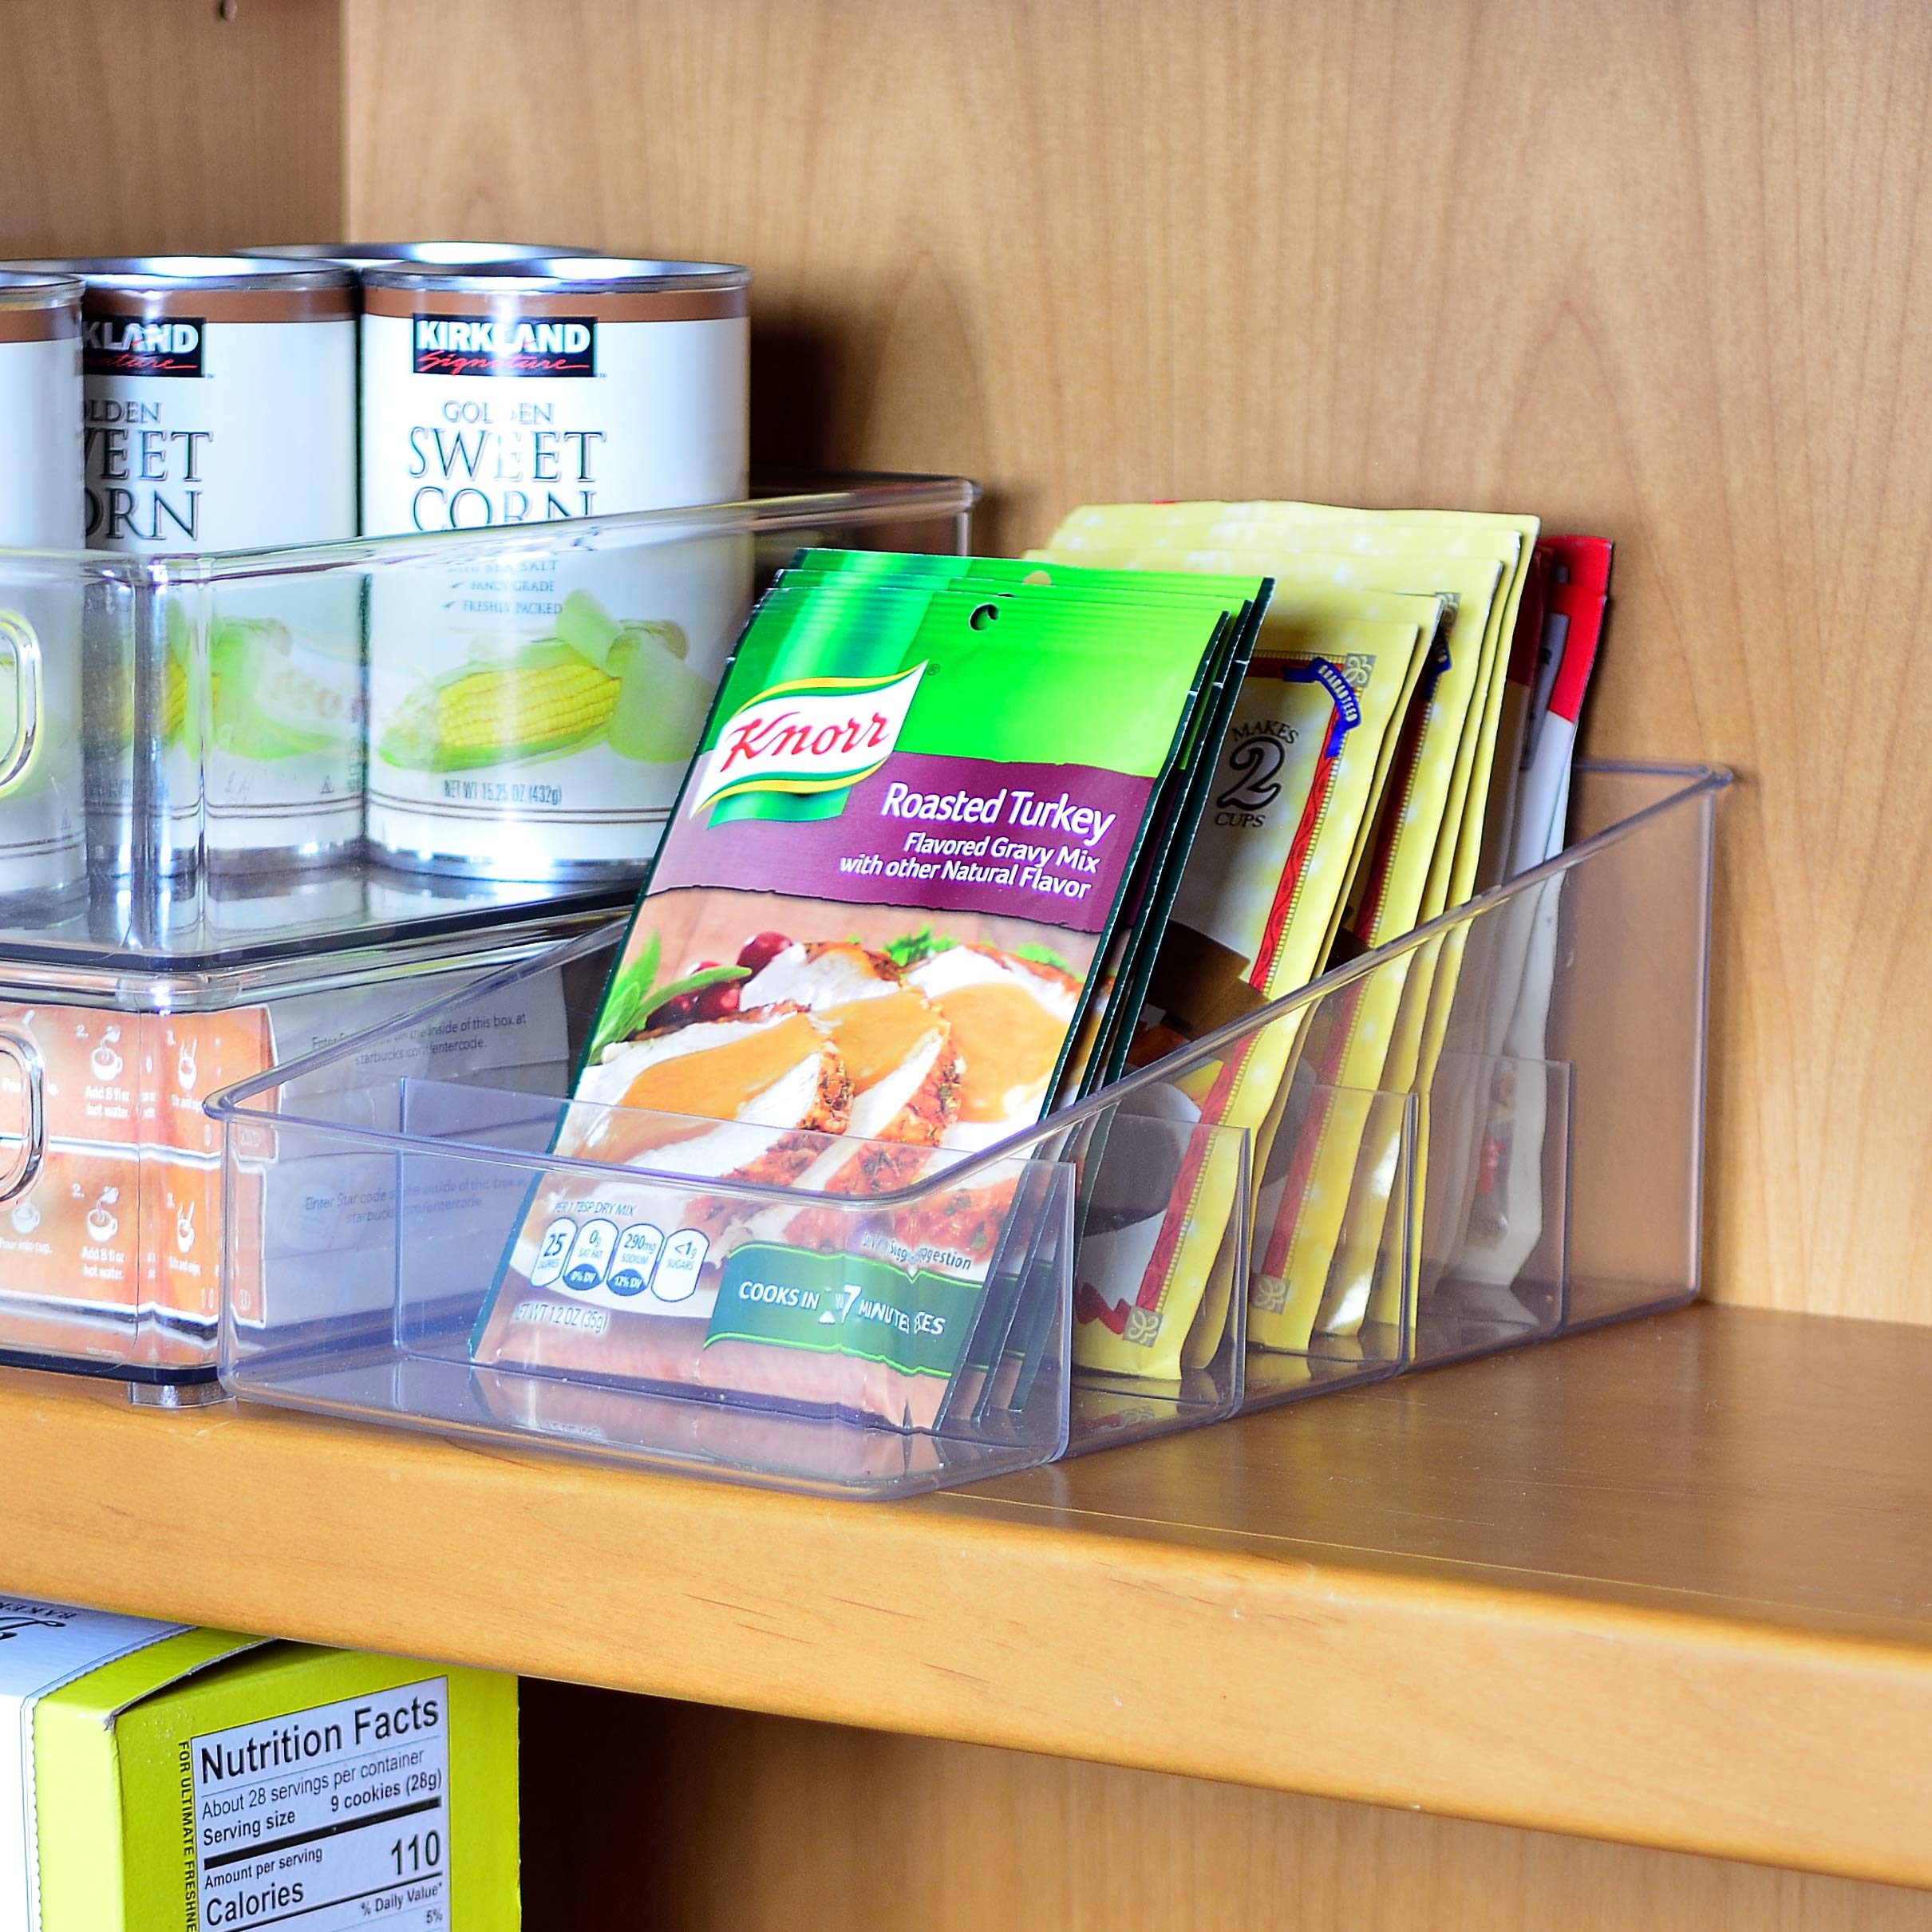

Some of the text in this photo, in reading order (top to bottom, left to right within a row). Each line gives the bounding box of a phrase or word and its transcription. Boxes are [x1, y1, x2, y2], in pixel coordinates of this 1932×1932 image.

[83, 322, 199, 354] KLAND
[416, 320, 591, 354] KIRKLAND
[417, 350, 590, 376] Signature
[444, 401, 554, 425] GOLEN
[513, 580, 556, 592] GRADE
[516, 601, 563, 614] PACKED
[1318, 663, 1359, 723] GUARANTEED
[721, 711, 890, 773] Knorr
[1231, 720, 1299, 745] MAKES
[1216, 736, 1286, 811] 2
[529, 784, 563, 806] (432g)
[879, 781, 1116, 847] Roasted Turkey
[1215, 812, 1266, 828] CUPS
[903, 832, 1102, 875] Flavored Gravy Mix
[839, 853, 1092, 901] with other Natural Flavor
[428, 1021, 457, 1037] inside
[461, 1018, 472, 1033] of
[472, 1015, 490, 1029] this
[494, 1013, 514, 1028] box
[516, 1012, 527, 1025] at
[85, 1085, 105, 1099] Add
[86, 1102, 102, 1116] hot
[595, 1203, 614, 1215] DRY
[616, 1203, 636, 1217] MIX
[82, 1246, 99, 1259] Add
[543, 1233, 567, 1257] 25
[83, 1264, 97, 1277] hot
[529, 1303, 549, 1321] WT
[565, 1306, 581, 1326] OZ
[582, 1309, 608, 1333] (35g)
[739, 1281, 799, 1307] COOKS
[801, 1290, 820, 1311] IN
[842, 1284, 862, 1324] 7
[201, 1696, 439, 1784] Nutrition Facts
[202, 1749, 425, 1820] About 28 servings per container
[330, 1768, 442, 1812] 9 cookies (28g)
[178, 1740, 197, 1932] FOR ULTIMATE FRESHNE
[203, 1810, 296, 1846] Serving size
[391, 1829, 441, 1875] 110
[204, 1847, 323, 1890] Amount per serving
[206, 1881, 304, 1926] Calories
[361, 1901, 371, 1916] %
[375, 1894, 403, 1913] Daily
[426, 1907, 443, 1923] 5%
